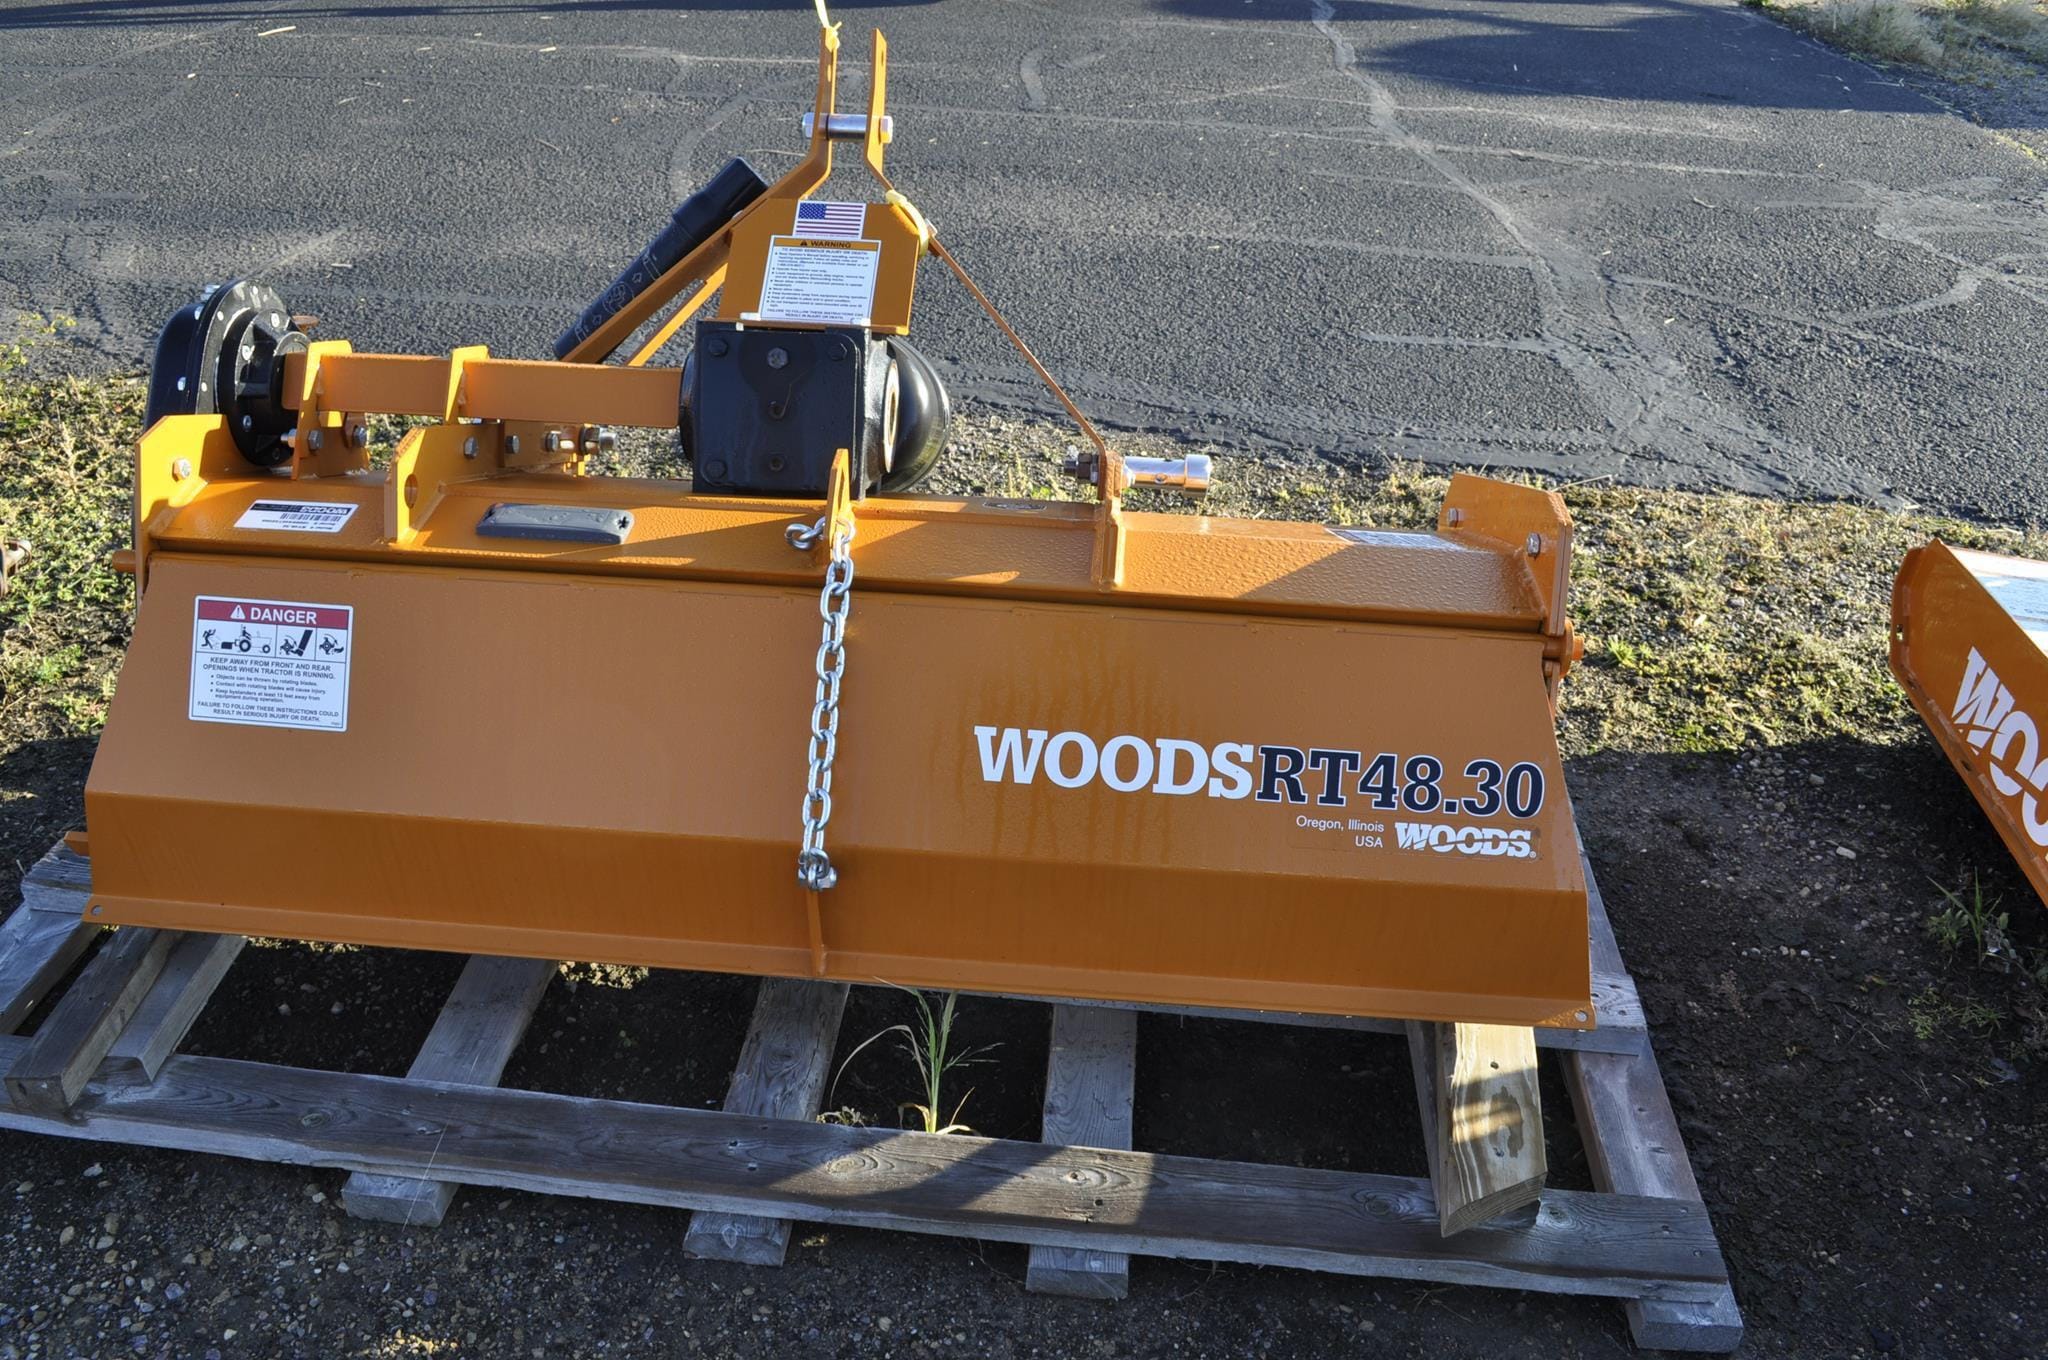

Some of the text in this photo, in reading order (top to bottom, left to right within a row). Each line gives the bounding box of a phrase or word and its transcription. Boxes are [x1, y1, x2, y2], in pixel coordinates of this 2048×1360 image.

[811, 240, 851, 248] WARNING
[250, 607, 317, 624] DANGER
[202, 663, 237, 672] OPENINGS
[261, 667, 292, 676] TRACTOR
[311, 663, 330, 671] REAR
[275, 706, 317, 715] INSTRUCTIONS
[974, 725, 1545, 819] WOODS RT48.30
[1296, 815, 1385, 832] Oregon, Illinois
[1355, 836, 1384, 848] USA
